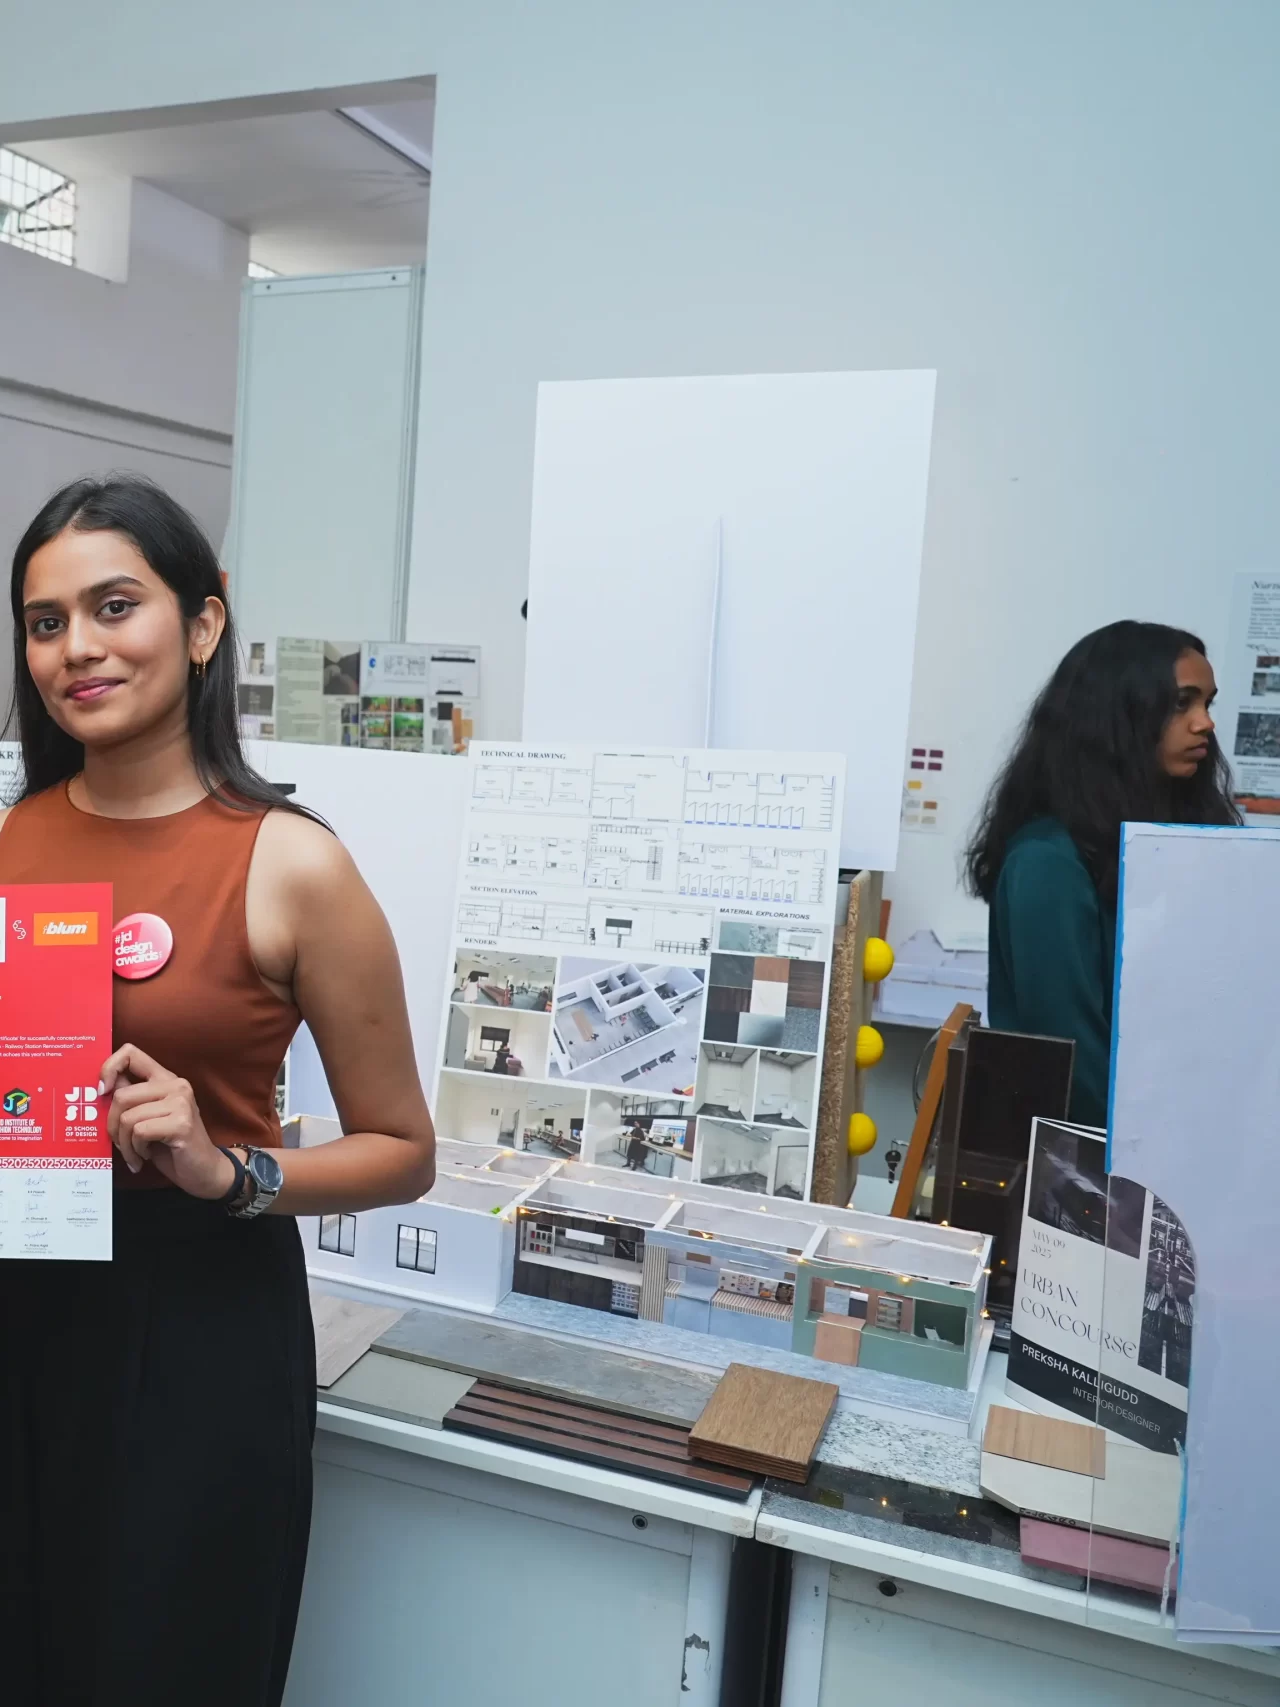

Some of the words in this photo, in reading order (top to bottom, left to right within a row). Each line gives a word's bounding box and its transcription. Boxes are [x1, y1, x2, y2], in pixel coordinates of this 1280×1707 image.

[481, 750, 525, 758] TECHNICAL
[528, 751, 566, 760] DRAWING
[470, 885, 499, 893] SECTION
[500, 888, 538, 896] ELEVATION
[719, 907, 754, 916] MATERIAL
[755, 910, 811, 920] EXPLORATIONS
[46, 921, 88, 935] blum
[114, 930, 133, 945] #jd
[464, 937, 497, 945] RENDERS
[114, 941, 153, 956] design
[115, 951, 159, 967] awards
[4, 1118, 29, 1126] INSTITUTE
[28, 1118, 36, 1126] OF
[12, 1126, 43, 1134] TECHNOLOGY
[1032, 1229, 1051, 1246] MAY
[1052, 1237, 1066, 1250] 09
[1030, 1243, 1052, 1259] 2025
[1023, 1268, 1079, 1308] URBAN
[1022, 1343, 1069, 1375] PREKSHA
[1071, 1366, 1139, 1405] KALLIGUDD
[1072, 1386, 1114, 1412] INTERIOR
[1115, 1406, 1161, 1435] DESIGNER
